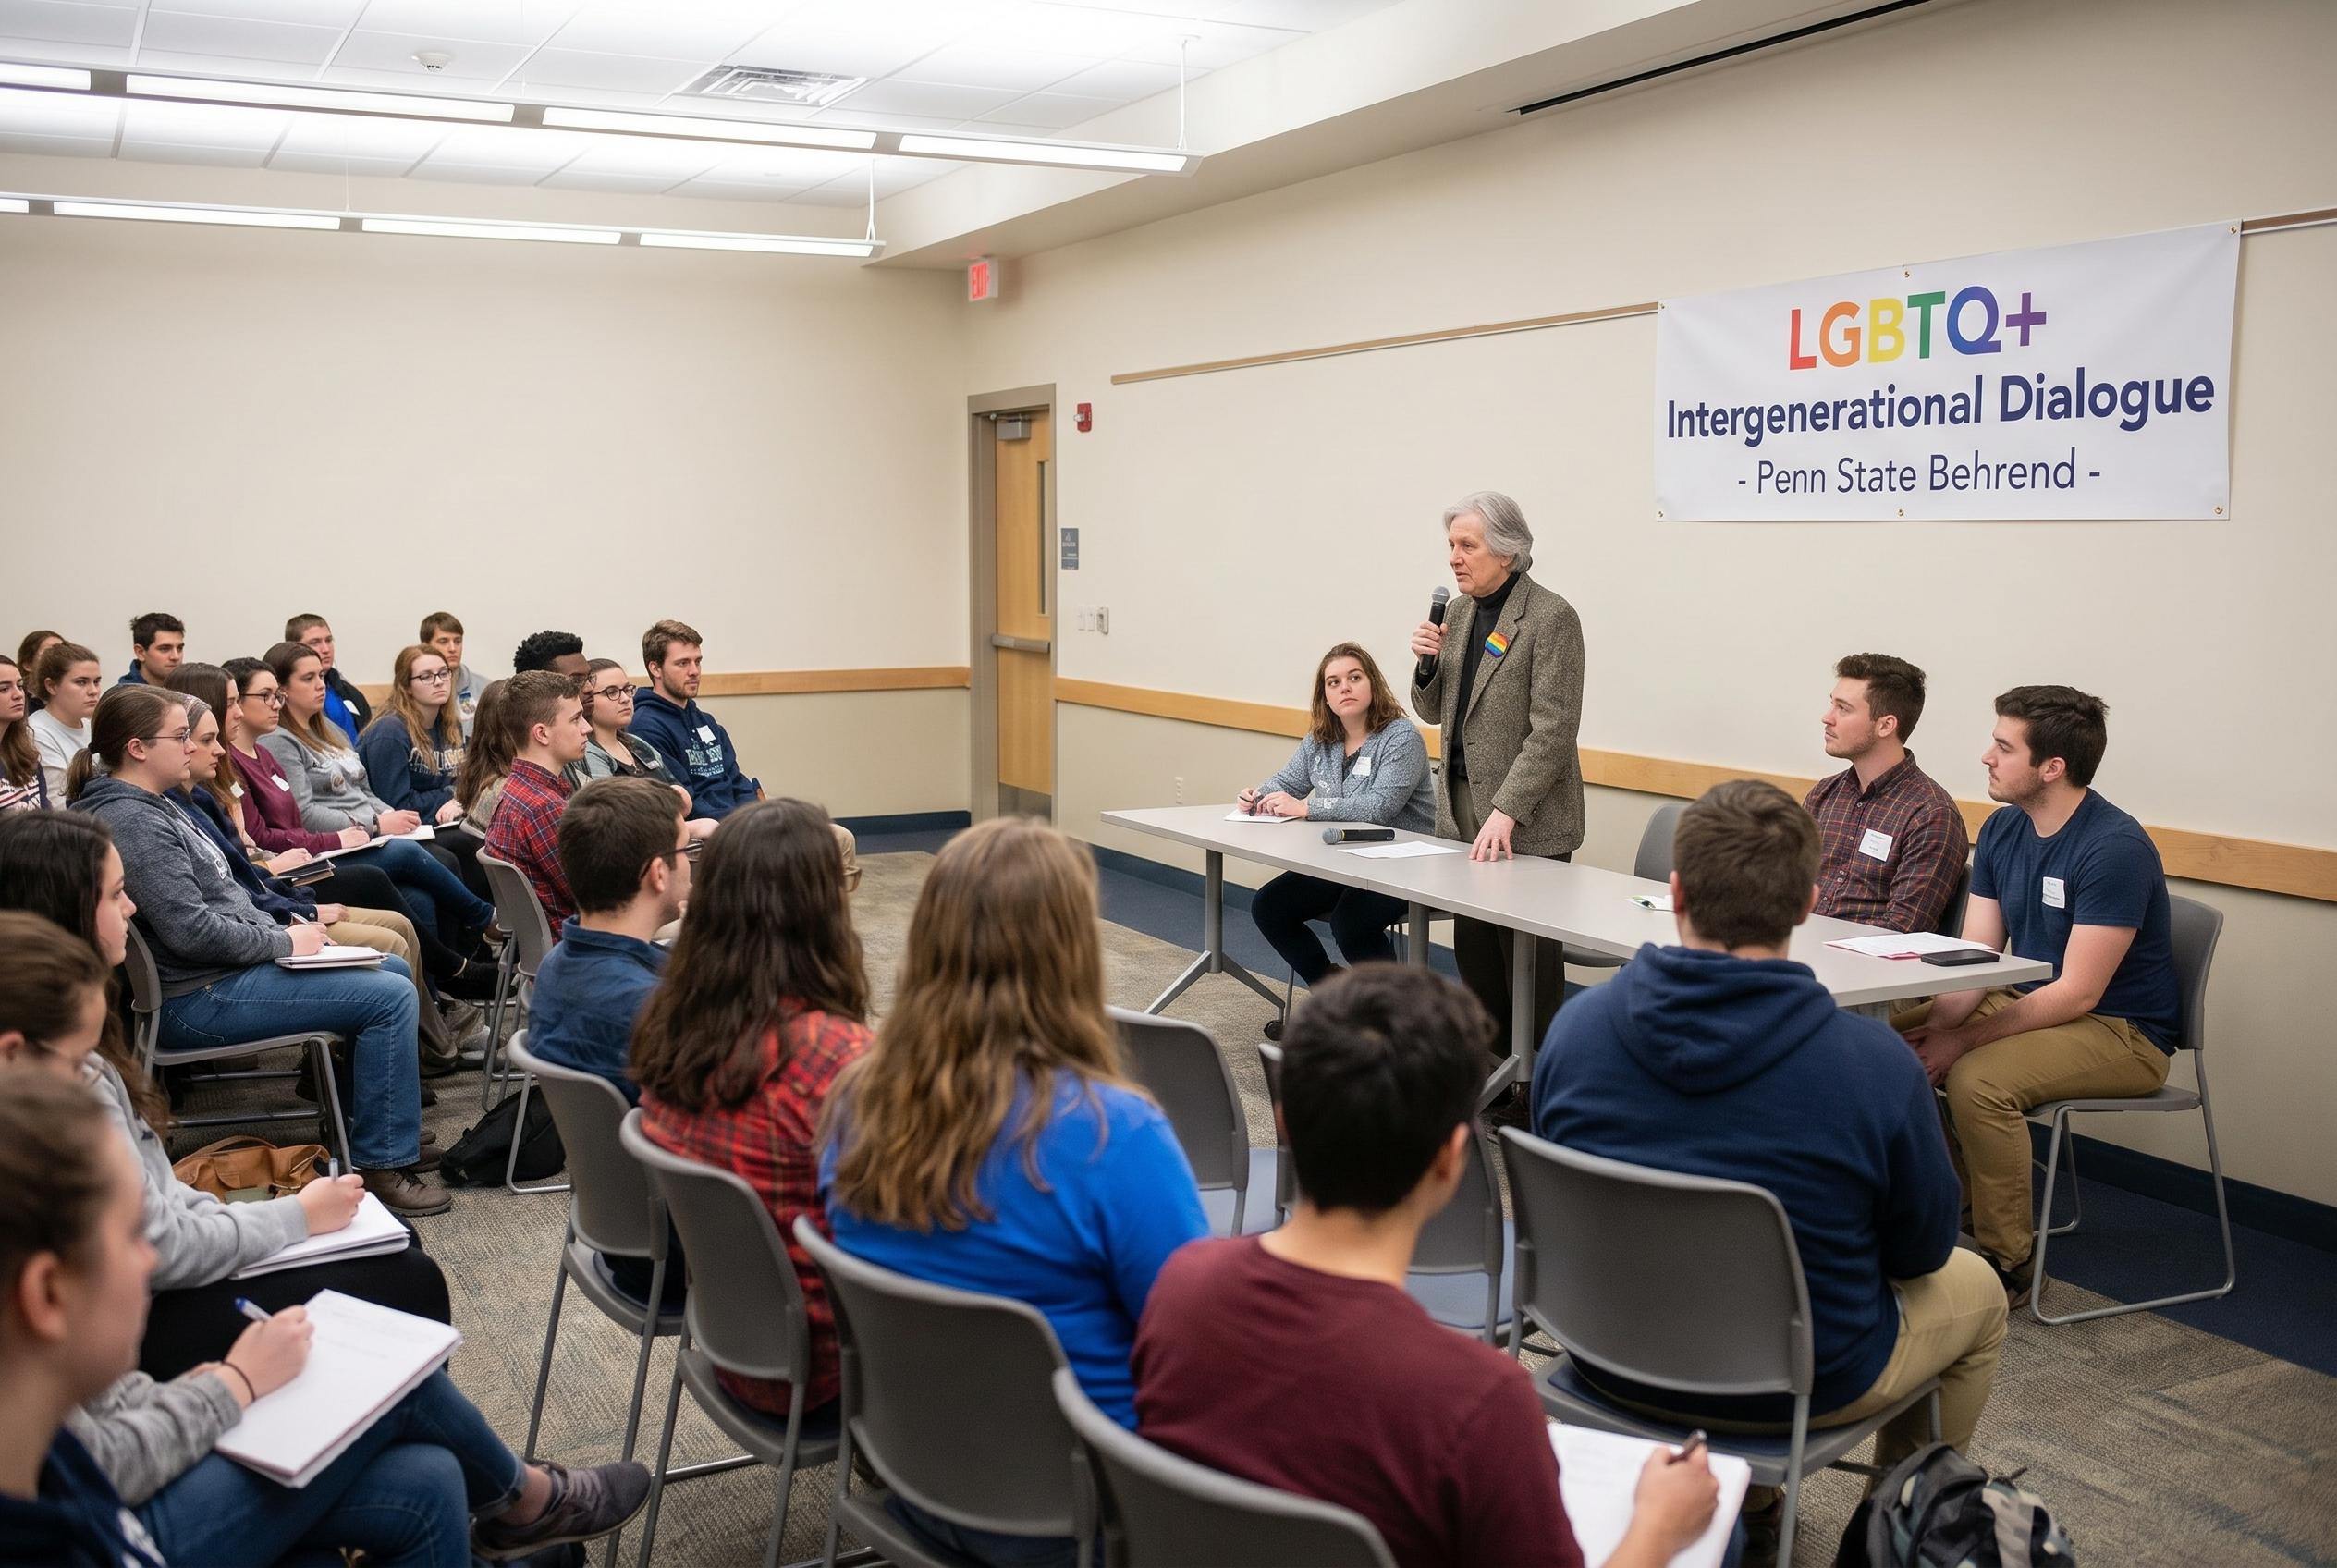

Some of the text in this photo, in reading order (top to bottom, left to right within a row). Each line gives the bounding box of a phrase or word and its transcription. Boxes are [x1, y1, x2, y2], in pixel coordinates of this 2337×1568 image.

[1789, 285, 2048, 371] LGBTQ+
[1668, 366, 2215, 447] Intergenerational Dialogue
[1757, 459, 1827, 494] Penn
[1837, 457, 1917, 494] State
[1929, 446, 2076, 491] Behrend
